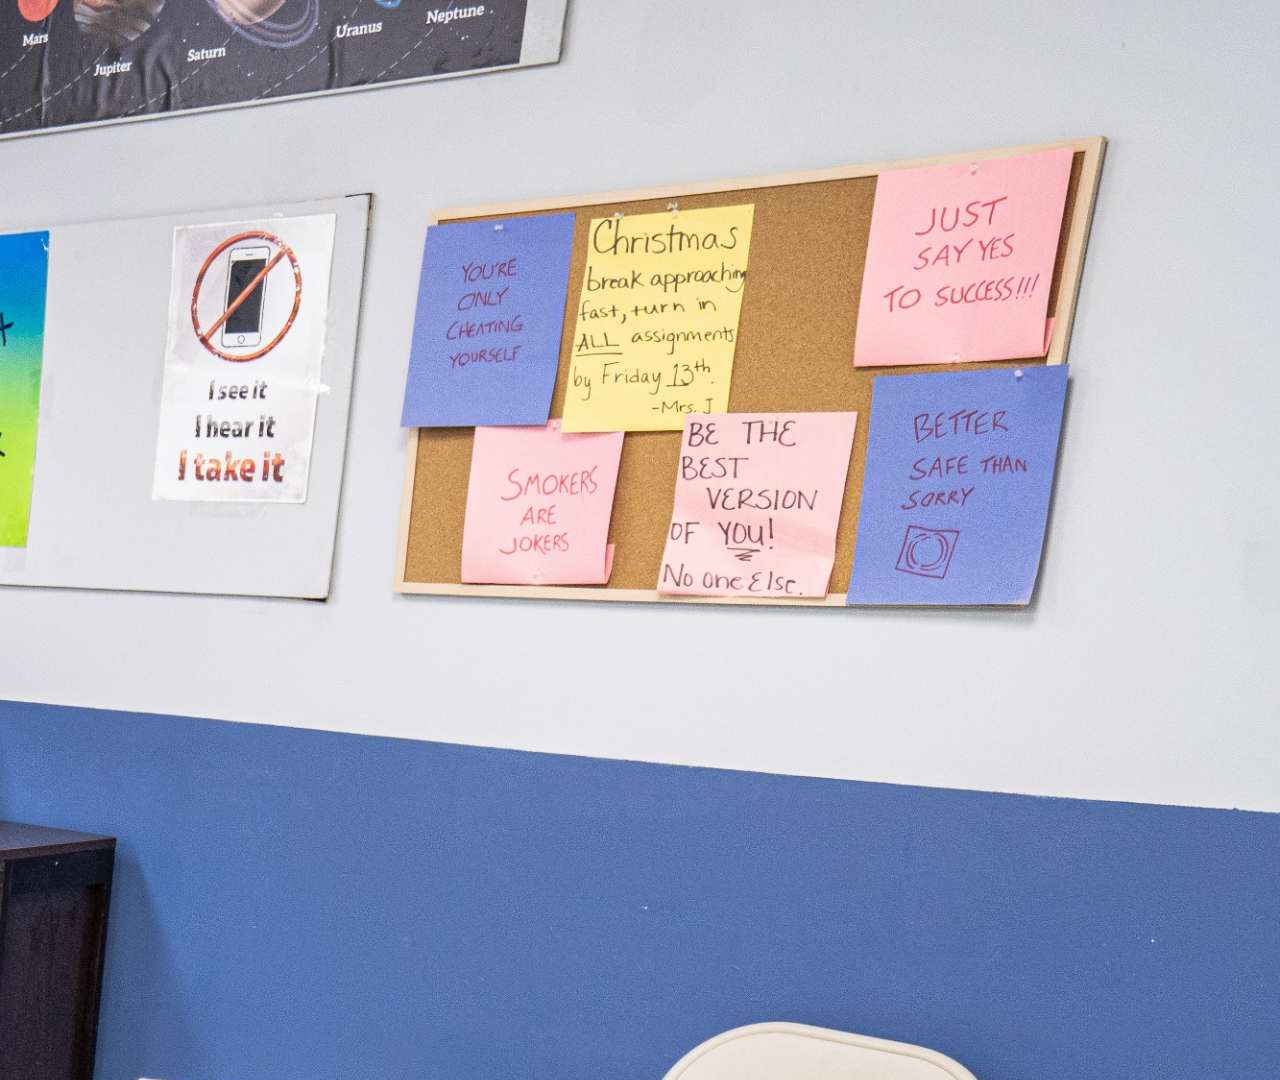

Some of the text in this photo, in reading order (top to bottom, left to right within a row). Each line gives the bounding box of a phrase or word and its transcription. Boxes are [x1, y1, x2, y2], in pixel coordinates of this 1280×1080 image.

[425, 3, 485, 25] Neptune
[22, 32, 49, 47] Mars
[334, 20, 383, 39] Uranus
[186, 45, 226, 62] Saturn
[93, 59, 132, 77] Jupiter
[915, 196, 1008, 236] JUST
[593, 218, 739, 256] Christmas
[913, 233, 1015, 270] SAY YES
[462, 257, 517, 282] YOU'RE
[587, 261, 748, 294] break approaching
[457, 288, 509, 311] ONLY
[883, 273, 1040, 312] TO SUCCESS!!!
[578, 298, 717, 324] fast, turn in
[446, 314, 523, 341] CHEATING
[575, 328, 735, 355] ALL assignments
[449, 345, 522, 369] YOURSELF
[208, 380, 268, 400] I see it
[572, 365, 592, 401] by
[601, 361, 662, 395] Friday
[702, 397, 714, 414] J
[195, 415, 276, 438] I hear it
[687, 420, 797, 448] BE THE
[913, 409, 1009, 443] BETTER
[177, 449, 285, 483] I take it
[681, 454, 749, 480] BEST
[908, 455, 1028, 481] SAFE THAN
[500, 465, 598, 501] SMOKERS
[705, 487, 818, 512] VERSION
[900, 487, 975, 510] SORRY
[520, 504, 557, 526] ARE
[498, 533, 570, 556] JOKERS
[670, 518, 775, 550] OF YOU!
[702, 571, 740, 590] one
